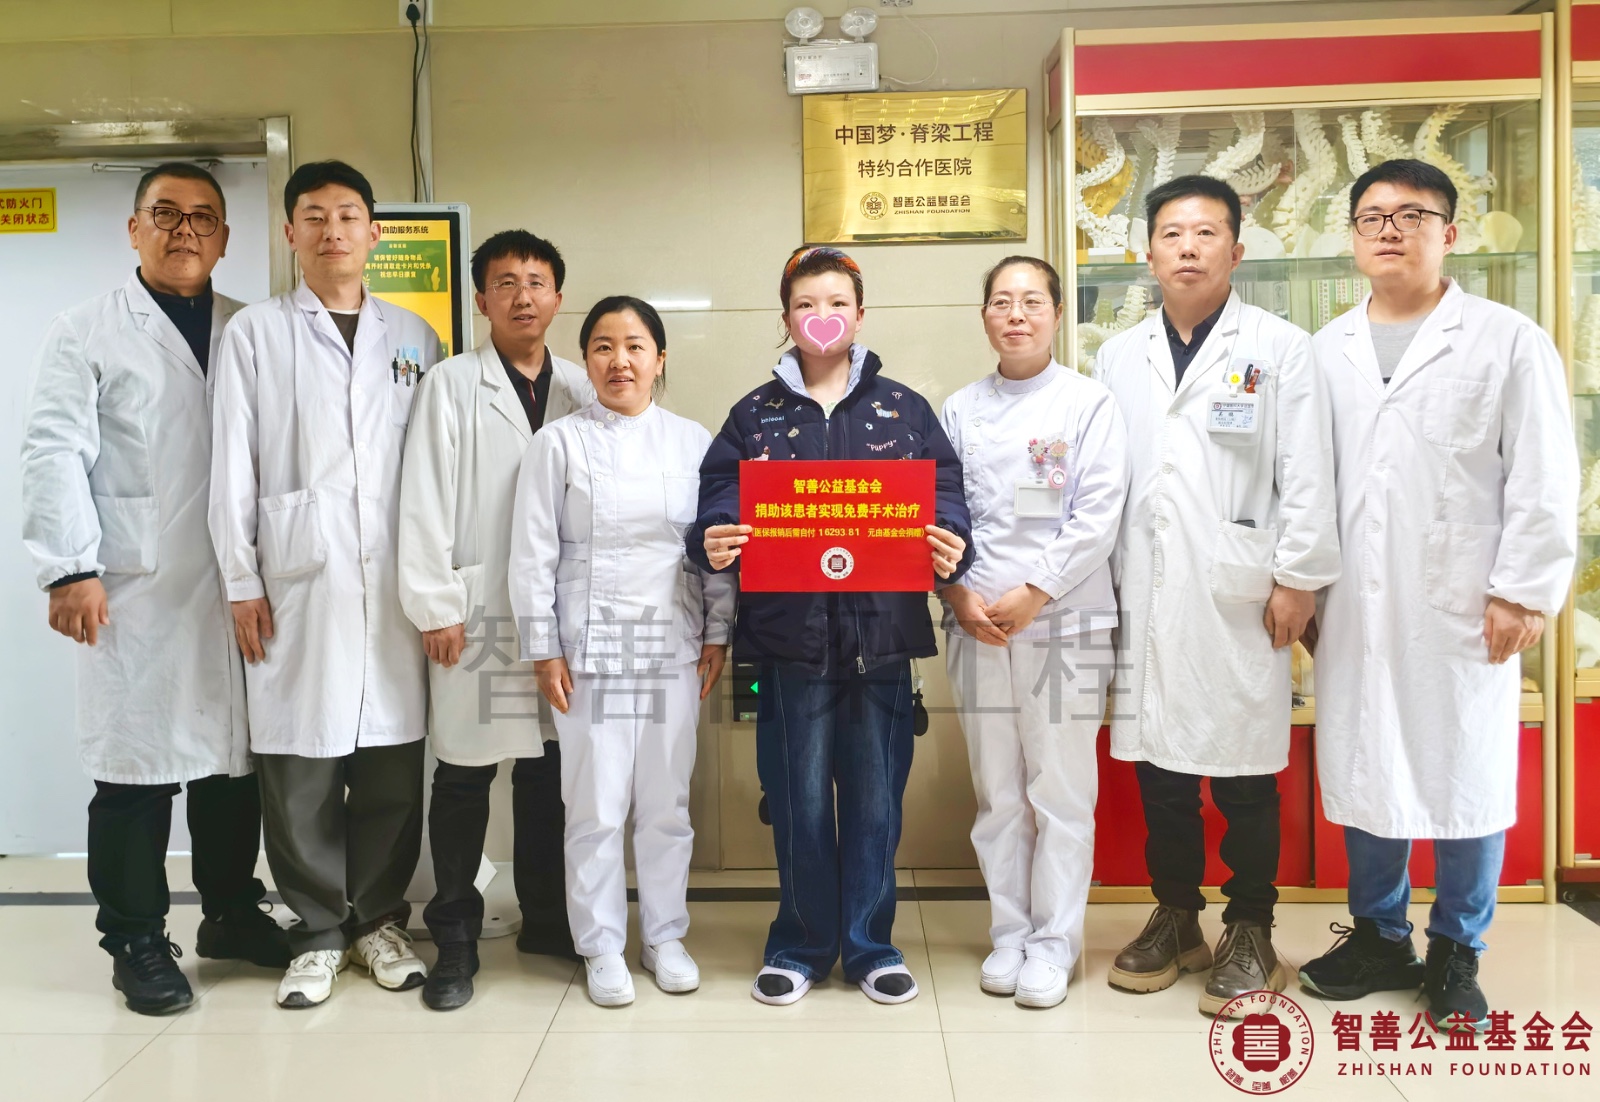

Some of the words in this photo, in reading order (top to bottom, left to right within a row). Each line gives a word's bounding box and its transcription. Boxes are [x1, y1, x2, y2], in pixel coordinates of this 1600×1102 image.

[835, 122, 994, 145] 中国梦·脊梁工程
[858, 158, 972, 178] 特约合作医院
[893, 195, 971, 207] 智善公益基金会
[1, 213, 49, 225] 关闭状态
[793, 478, 882, 494] 智善公益基金会
[755, 503, 920, 518] 捐助该患者实现免费手术治疗
